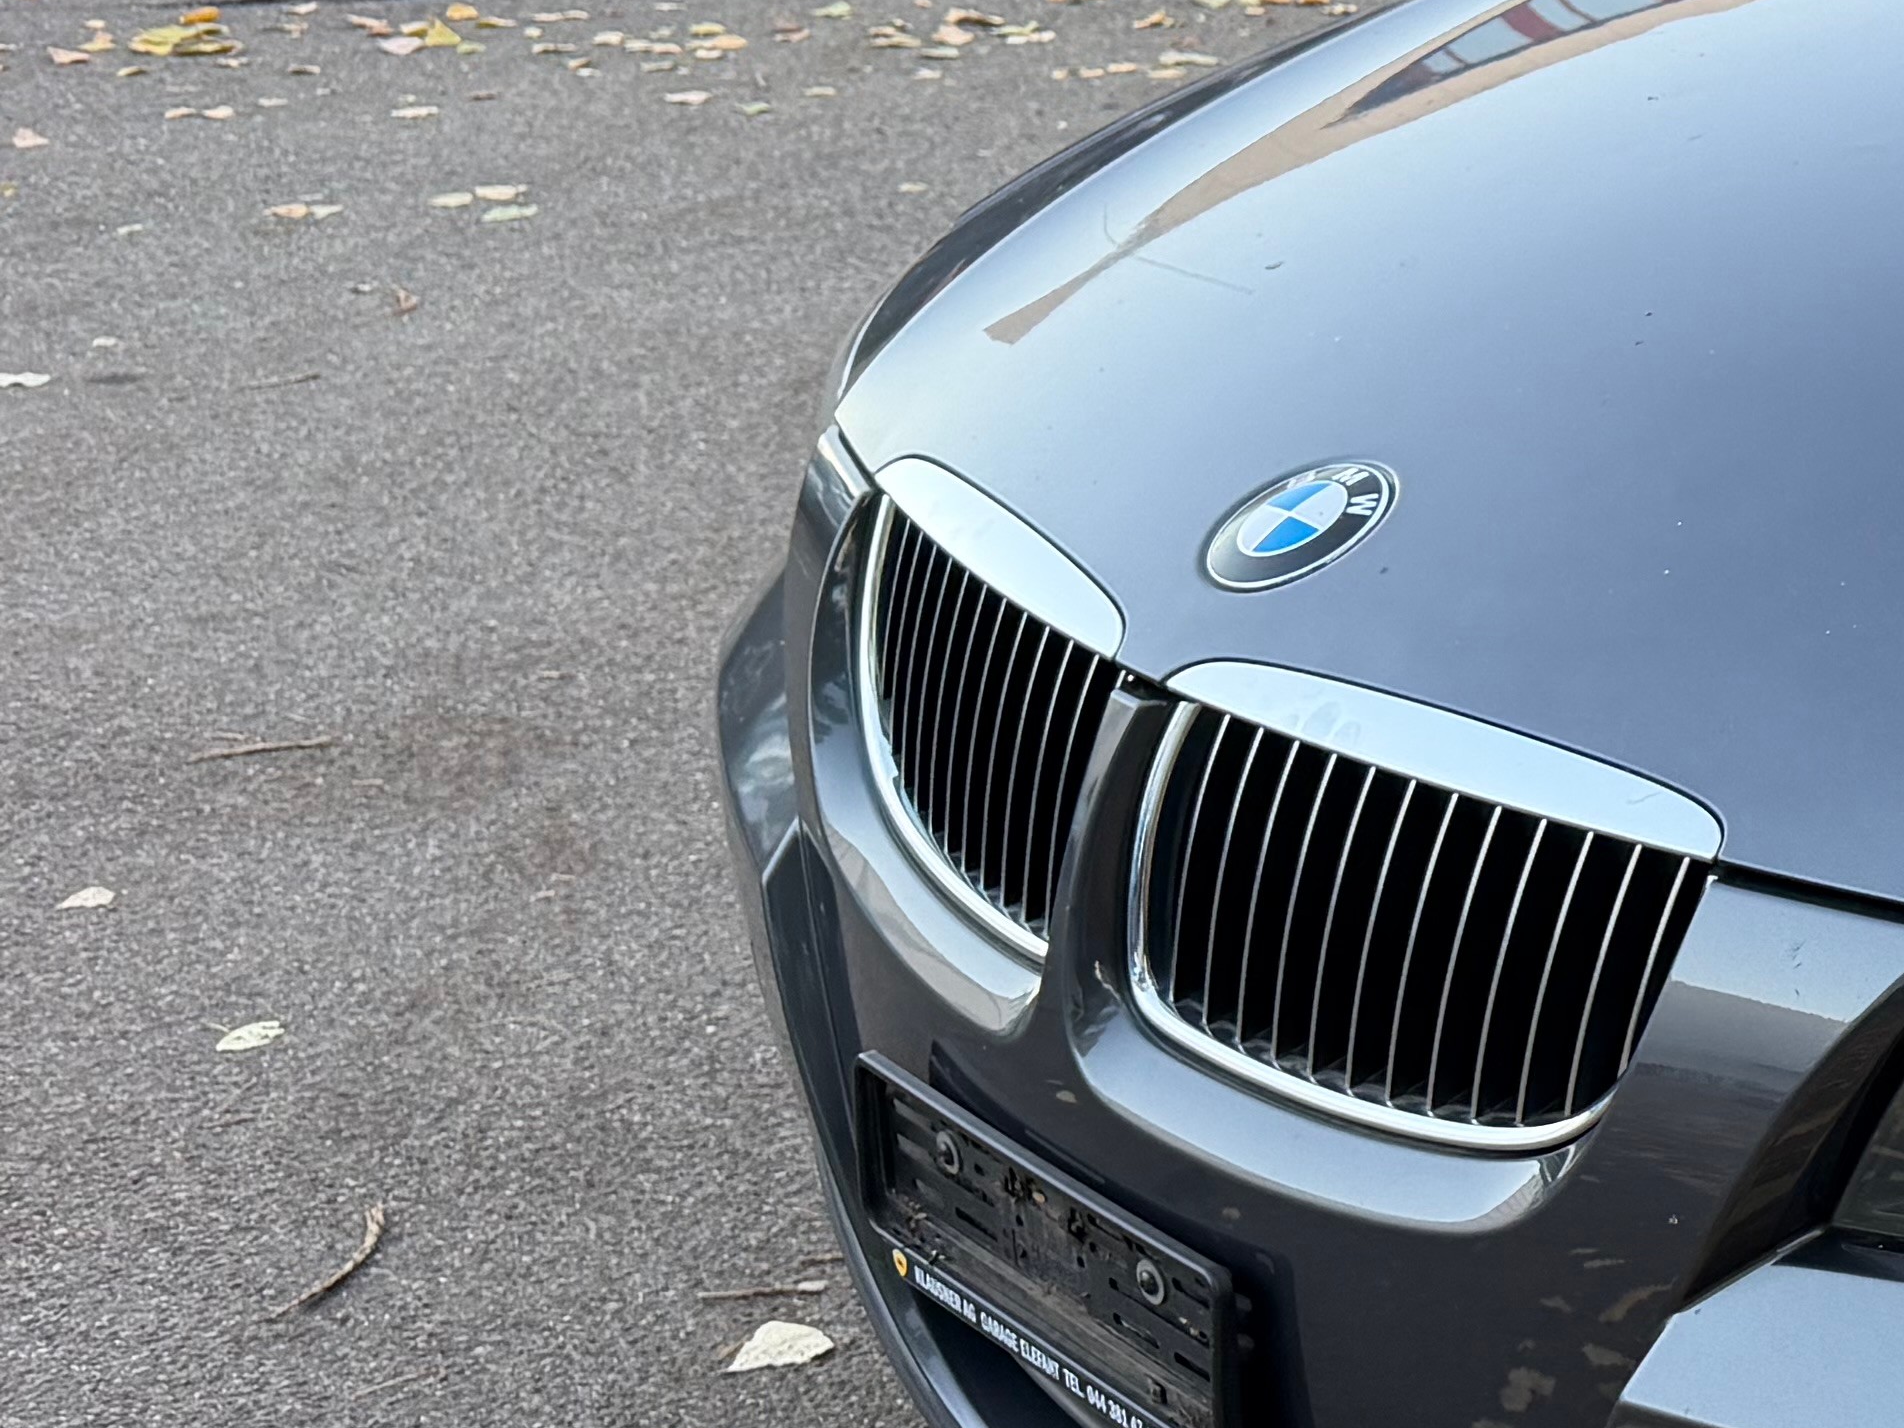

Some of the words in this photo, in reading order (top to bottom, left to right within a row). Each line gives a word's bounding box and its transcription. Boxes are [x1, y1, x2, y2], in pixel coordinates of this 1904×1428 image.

[963, 1299, 977, 1323] AG
[980, 1311, 1019, 1353] GARAGE
[1019, 1338, 1060, 1381] ELEFANT
[1086, 1384, 1107, 1414] 044
